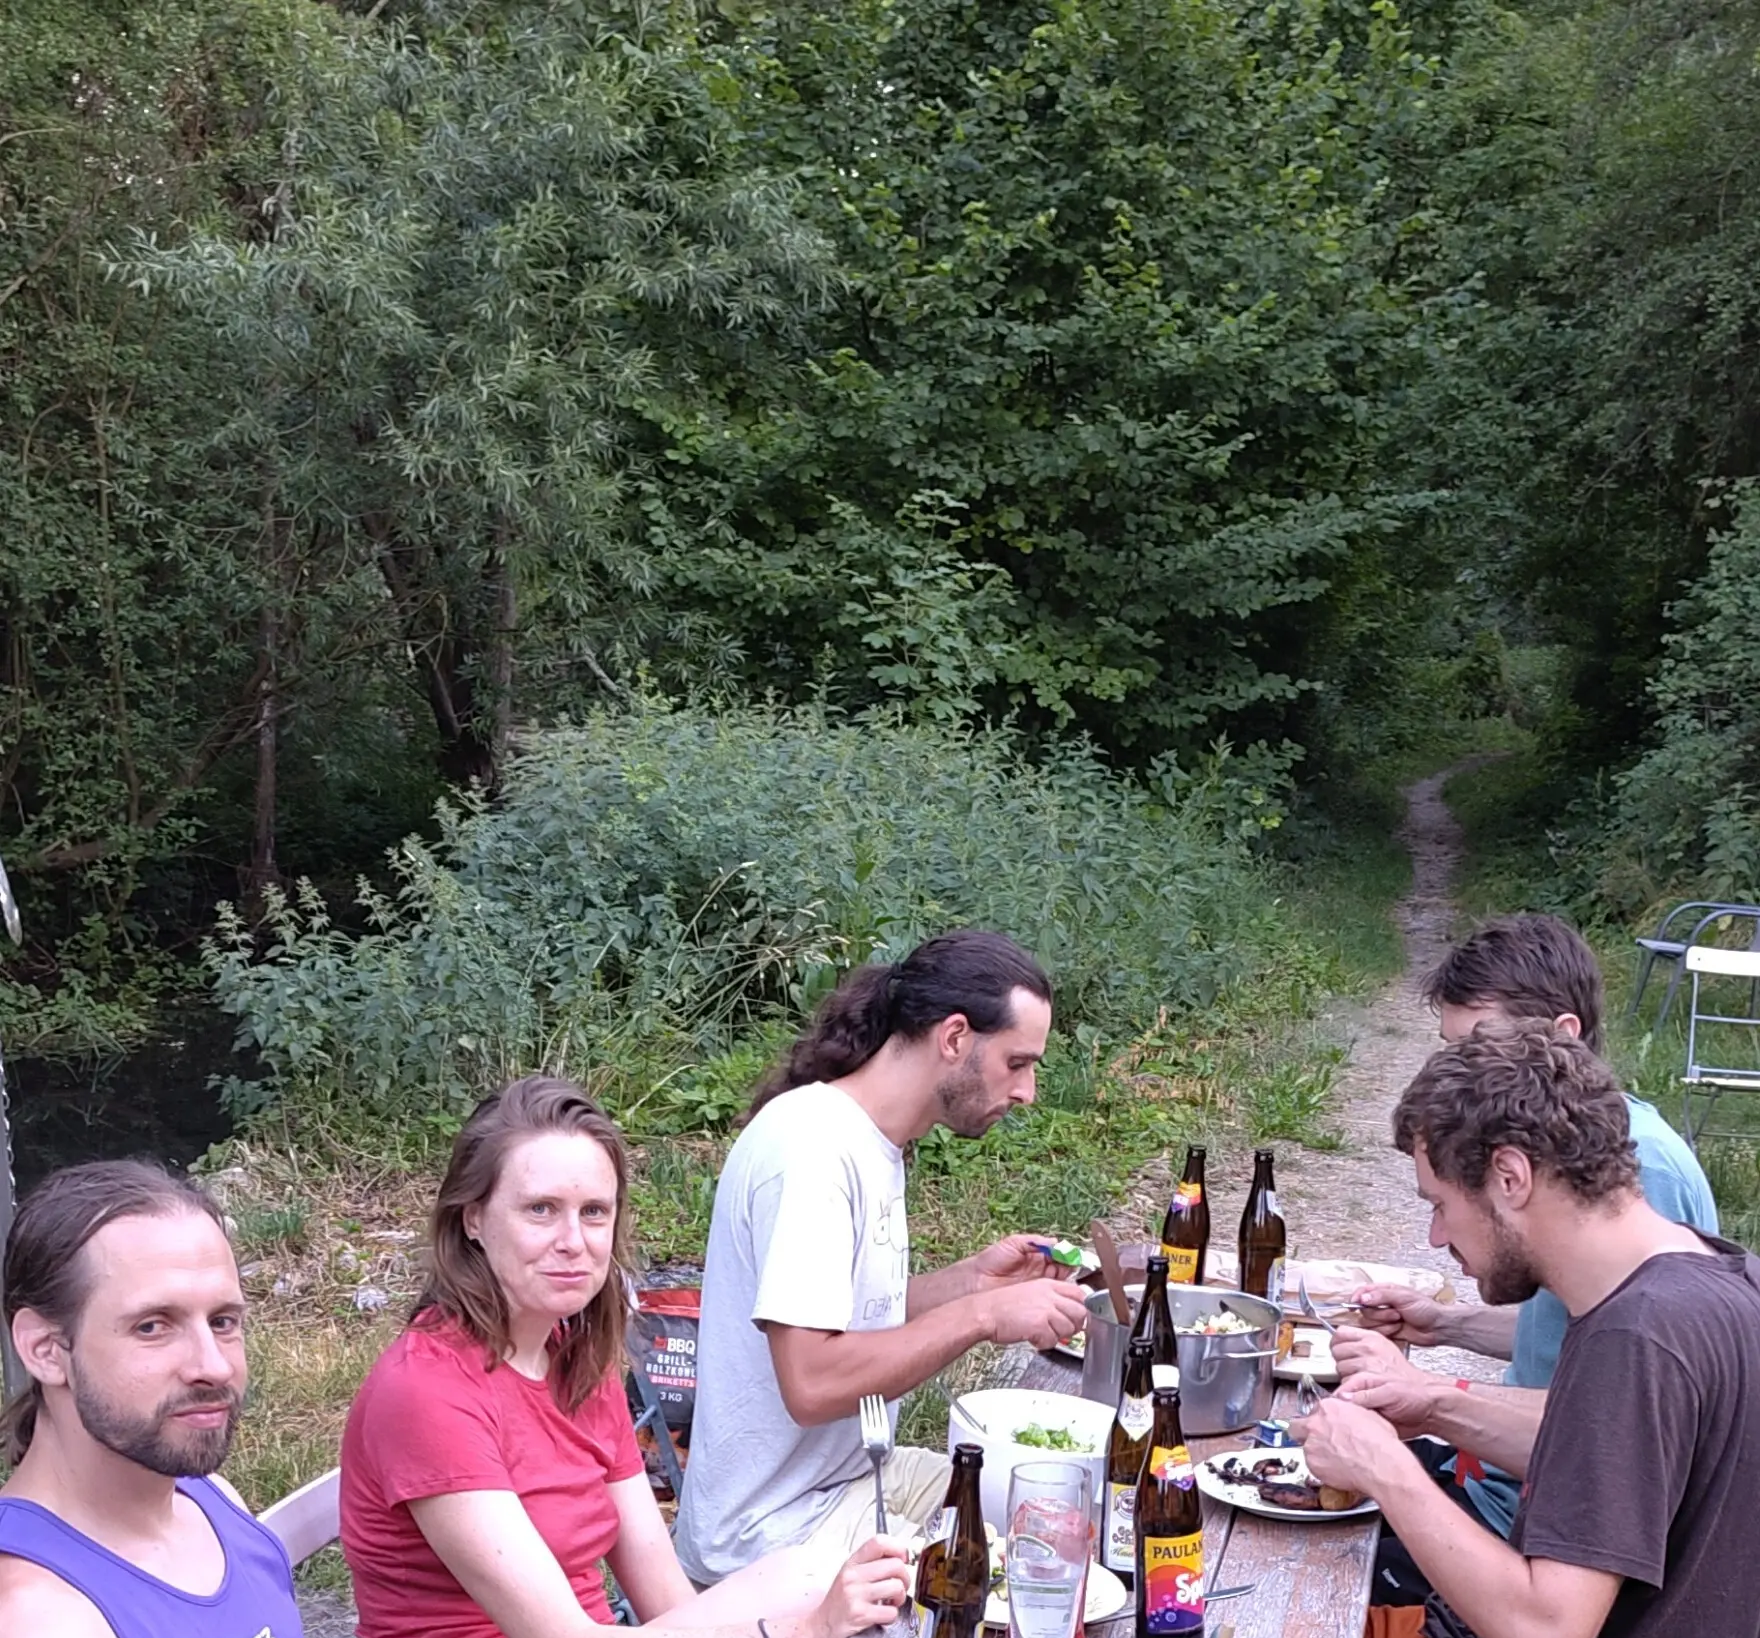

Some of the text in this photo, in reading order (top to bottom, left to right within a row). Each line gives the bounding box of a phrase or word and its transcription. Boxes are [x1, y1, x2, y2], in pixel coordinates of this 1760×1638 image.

[667, 1337, 696, 1356] BBQ
[657, 1353, 693, 1367] GRILL-
[646, 1362, 696, 1378] HOLZKOHL
[660, 1391, 683, 1402] 3 KG
